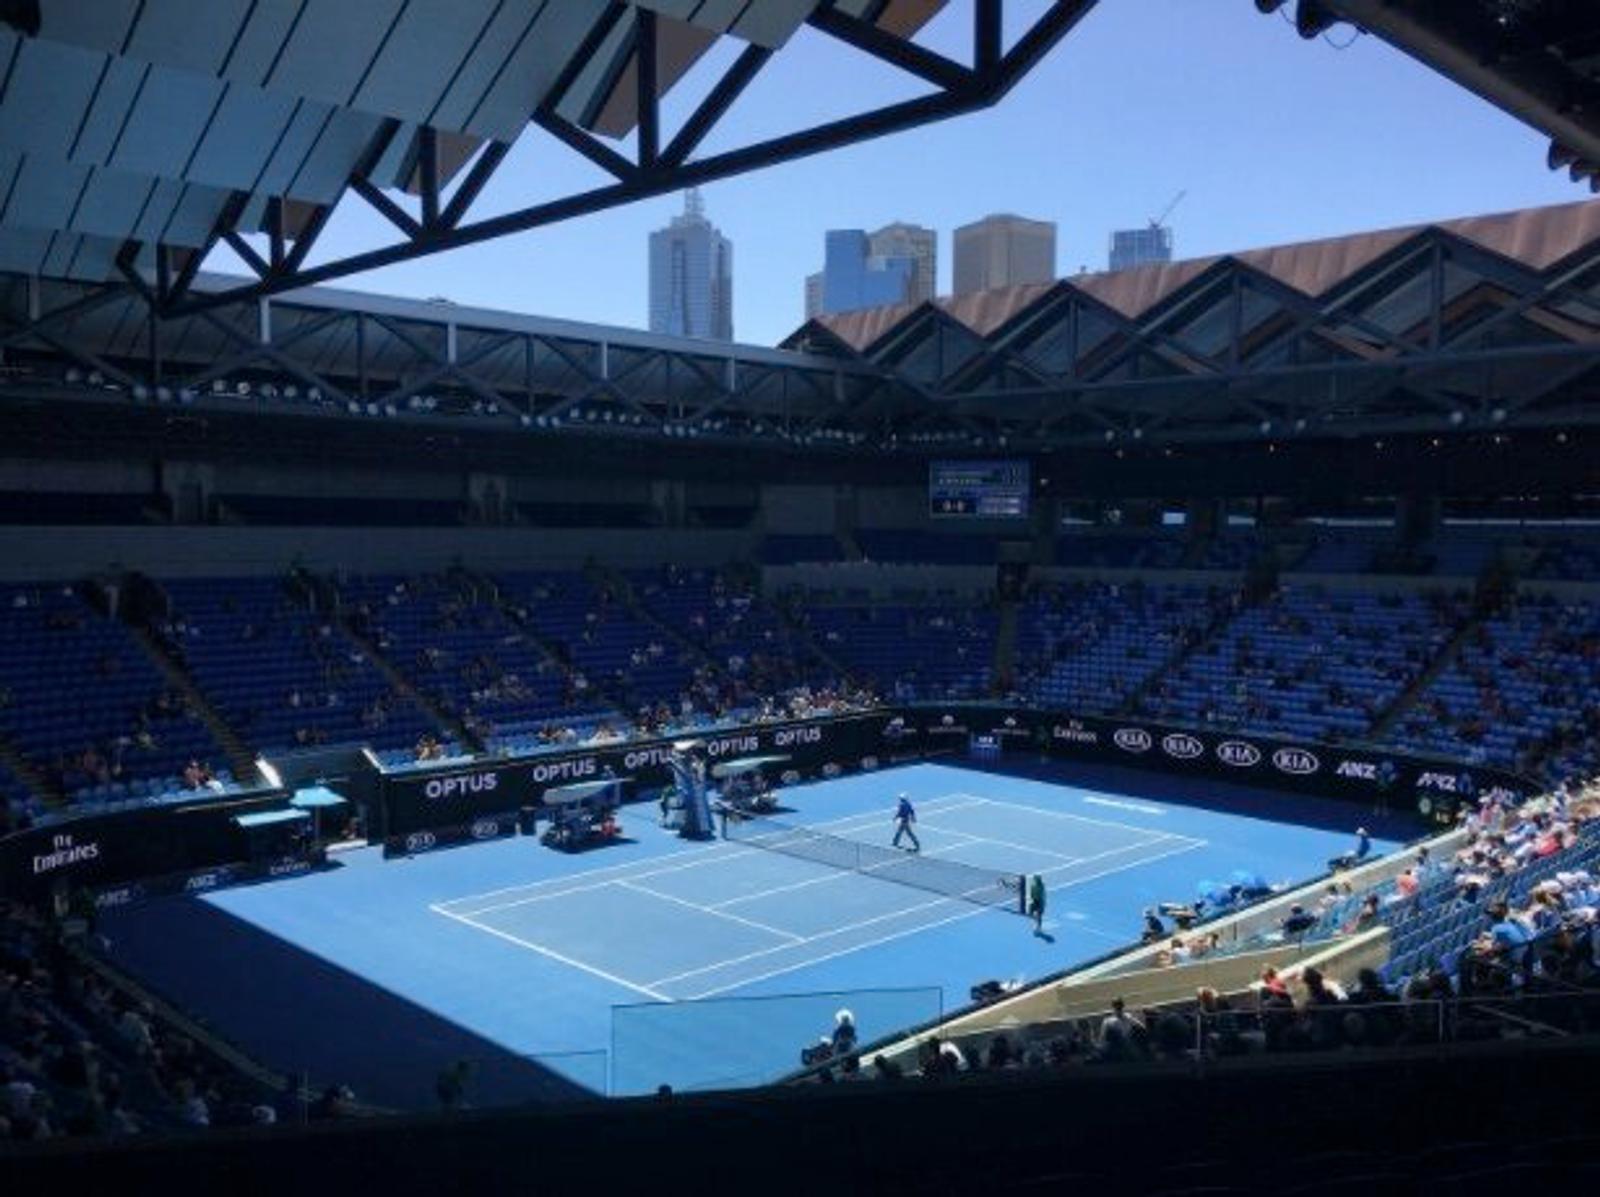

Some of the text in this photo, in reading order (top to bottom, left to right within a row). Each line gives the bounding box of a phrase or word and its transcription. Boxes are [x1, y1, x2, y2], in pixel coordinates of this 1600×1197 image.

[708, 736, 759, 756] OPTUS
[775, 727, 822, 746] OPTUS
[533, 758, 597, 782] OPTUS
[1336, 760, 1376, 780] ANZ
[426, 773, 497, 798] OPTUS
